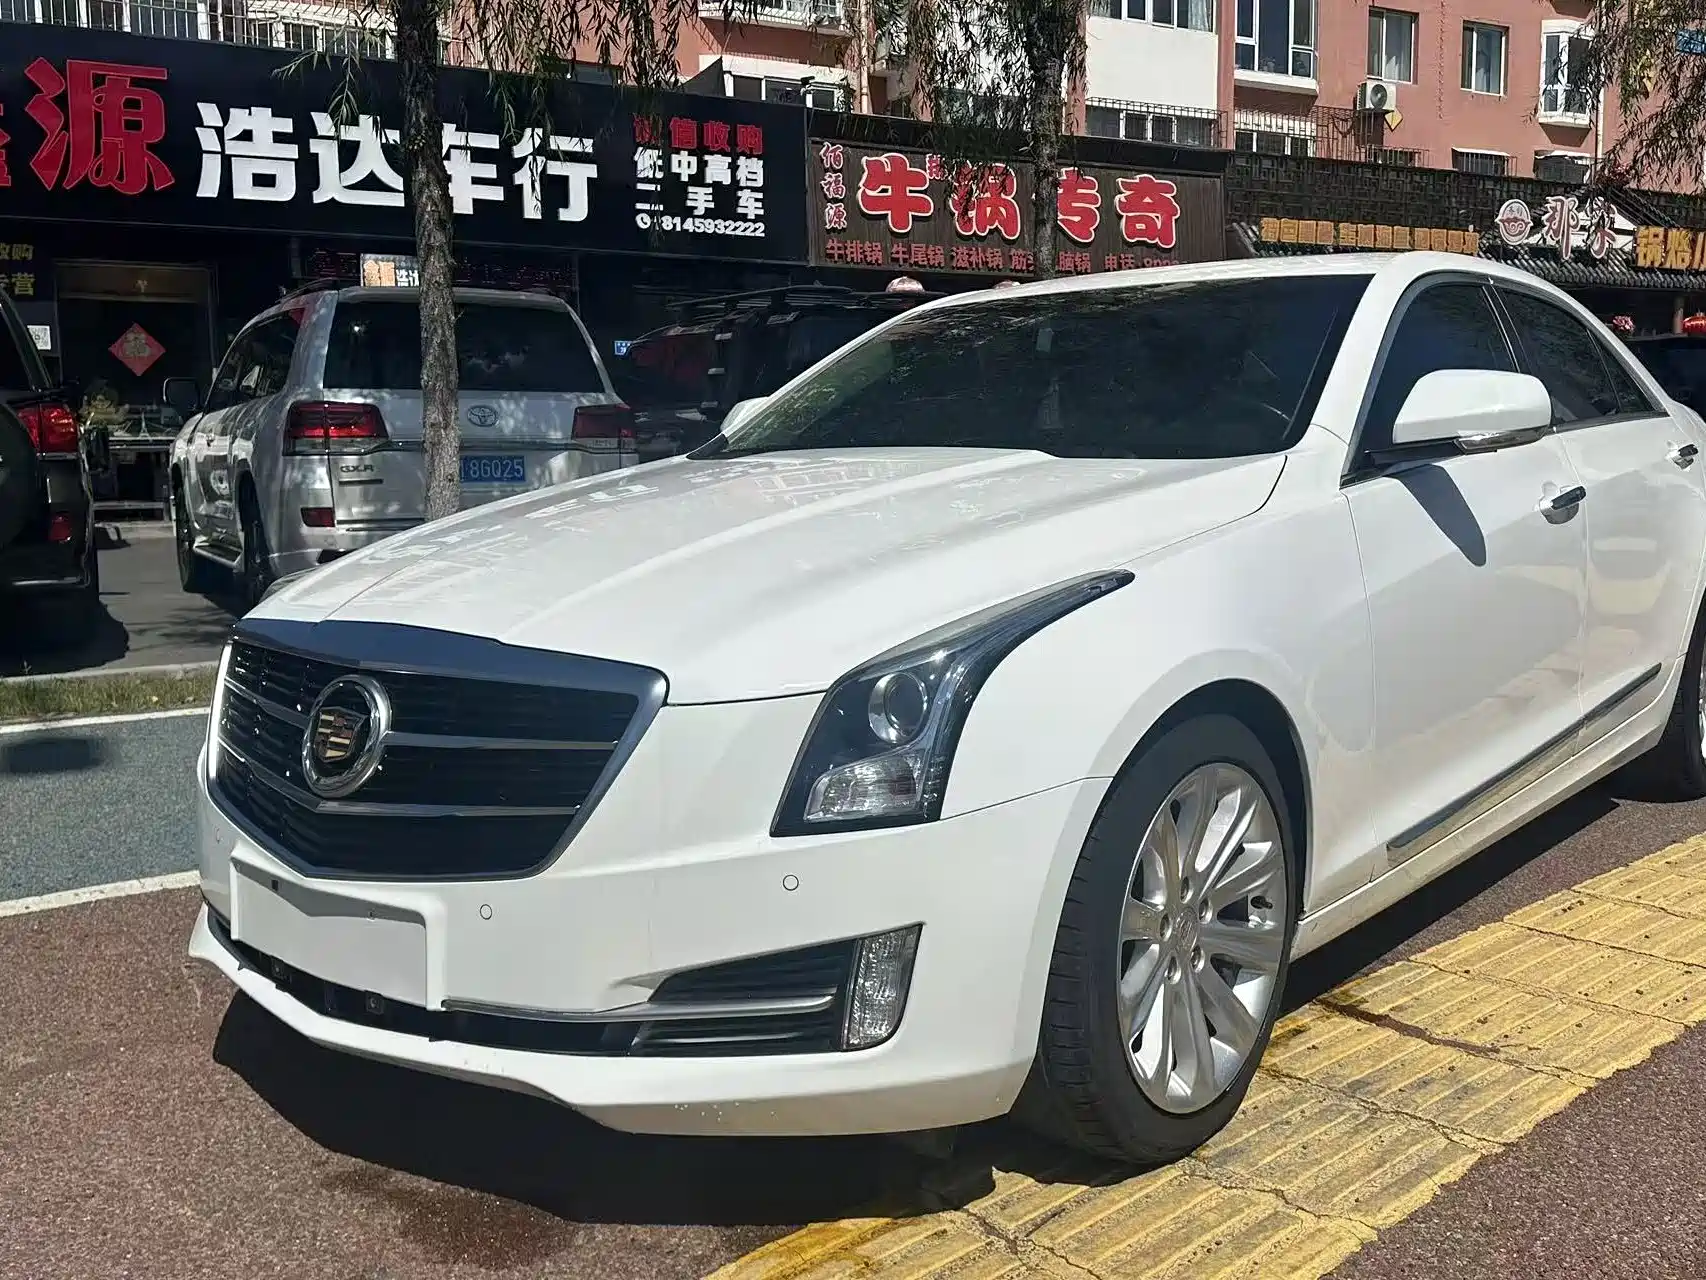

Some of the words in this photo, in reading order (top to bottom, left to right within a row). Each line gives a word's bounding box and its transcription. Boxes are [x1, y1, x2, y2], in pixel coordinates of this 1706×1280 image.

[0, 57, 175, 195] 源
[196, 102, 598, 222] 浩达车行
[635, 183, 765, 219] 二手车
[820, 142, 848, 230] 佰福源
[653, 215, 765, 237] 8145932222
[826, 239, 883, 265] 牛排锅
[891, 243, 945, 267] 牛尾锅
[952, 246, 1004, 270] 滋补锅
[1010, 248, 1092, 273] 筋脑锅
